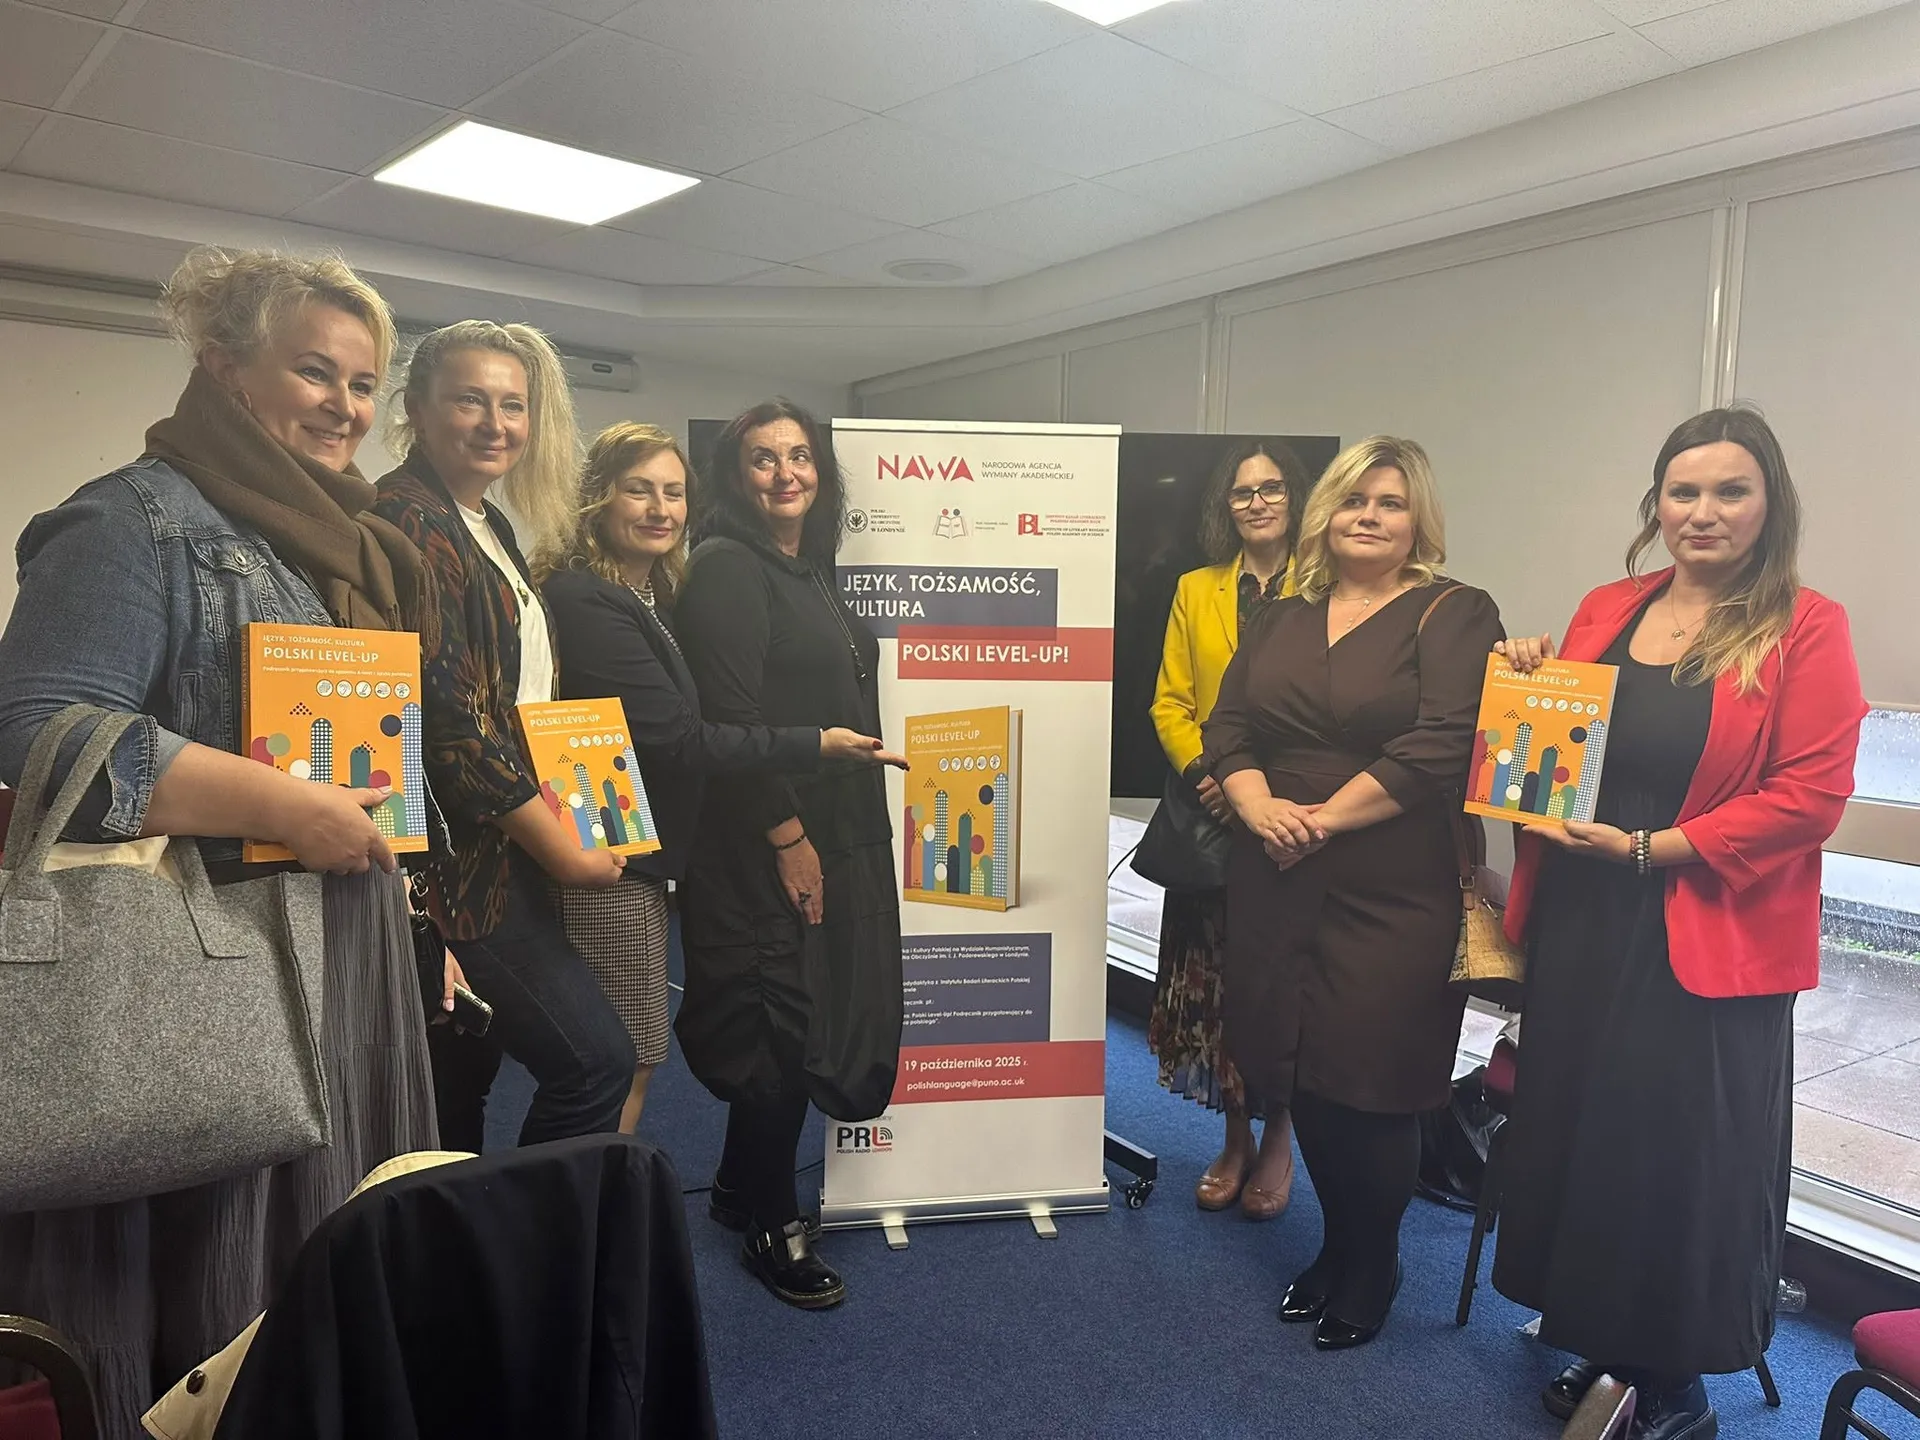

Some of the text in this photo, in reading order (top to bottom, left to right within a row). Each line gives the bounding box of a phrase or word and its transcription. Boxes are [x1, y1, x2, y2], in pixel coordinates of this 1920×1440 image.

[878, 454, 975, 482] NAWA
[1020, 472, 1074, 480] AKADEMICKIEJ
[844, 571, 1042, 596] JĘZYK, TOŻSAMOŚĆ,
[335, 639, 365, 648] KULTURA
[263, 647, 379, 664] POLSKI LEVEL-UP
[902, 644, 1069, 663] POLSKI LEVEL-UP!
[1494, 669, 1530, 681] POLSKI
[1532, 673, 1580, 687] LEVEL-UP
[530, 714, 601, 728] POLSKI LEVEL-UP
[911, 729, 980, 744] POLSKI LEVEL-UP
[905, 1060, 917, 1071] 19
[920, 1058, 992, 1072] października
[995, 1056, 1021, 1067] 2025
[907, 1078, 1025, 1092] polishlanguage@puno.ac.uk
[837, 1126, 892, 1148] PRL
